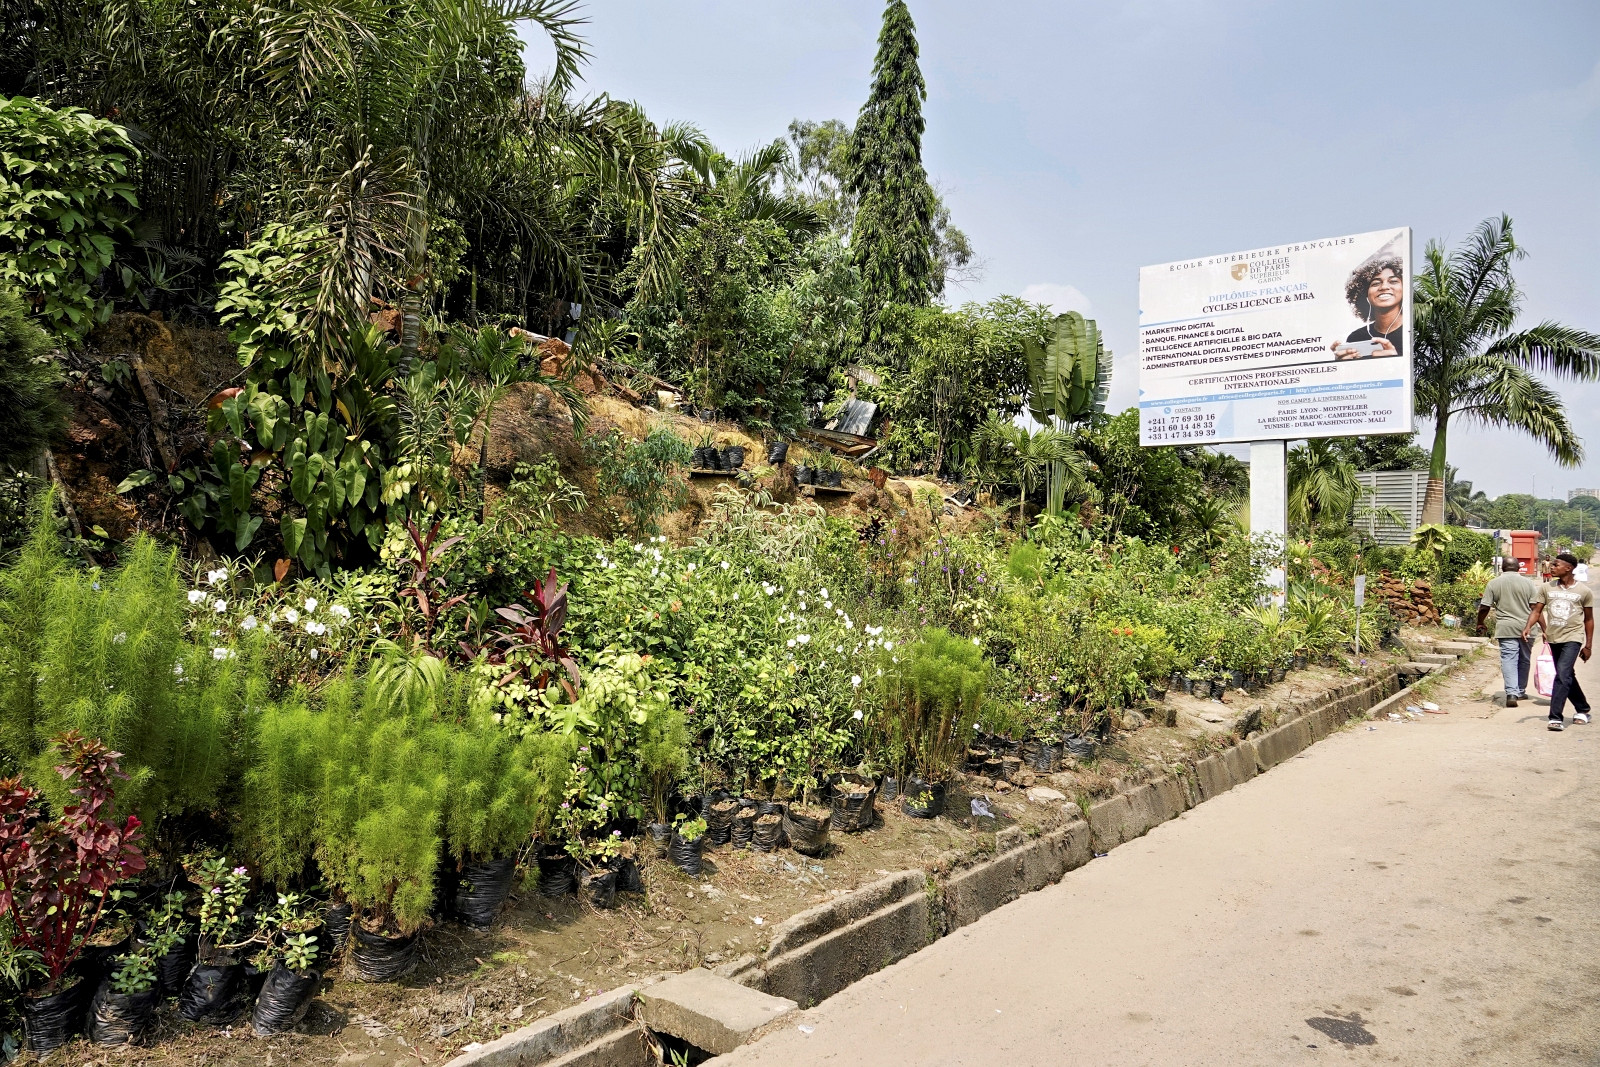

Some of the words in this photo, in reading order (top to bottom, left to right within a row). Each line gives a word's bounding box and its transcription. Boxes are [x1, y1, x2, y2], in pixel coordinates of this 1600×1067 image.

[1170, 262, 1202, 271] ÉCOLE
[1209, 249, 1280, 265] SUPÉRIEURE
[1288, 238, 1355, 253] FRANÇAISE
[1265, 263, 1290, 271] PARIS
[1209, 289, 1257, 302] DIPLÔMES
[1260, 283, 1308, 296] FRANÇAIS
[1203, 303, 1238, 313] CYCLES
[1240, 296, 1282, 308] LICENCE
[1294, 292, 1314, 301] MBA
[1146, 326, 1186, 336] MARKETING
[1188, 322, 1215, 330] DIGITAL
[1146, 336, 1176, 345] BANQUE,
[1178, 332, 1209, 340] FINANCE
[1217, 327, 1244, 335] DIGITAL
[1146, 343, 1192, 352] NTELLIGENCE
[1193, 337, 1240, 347] ARTIFICIELLE
[1146, 350, 1202, 361] INTERNATIONAL
[1232, 343, 1265, 352] PROJECT
[1267, 337, 1322, 348] MANAGEMENT
[1146, 359, 1207, 370] ADMINISTRATEUR
[1225, 352, 1264, 361] SYSTÈMES
[1266, 346, 1326, 357] D'INFORMATION
[1189, 374, 1253, 385] CERTIFICATIONS
[1256, 366, 1338, 379] PROFESSIONNELLES
[1225, 378, 1300, 390] INTERNATIONALES
